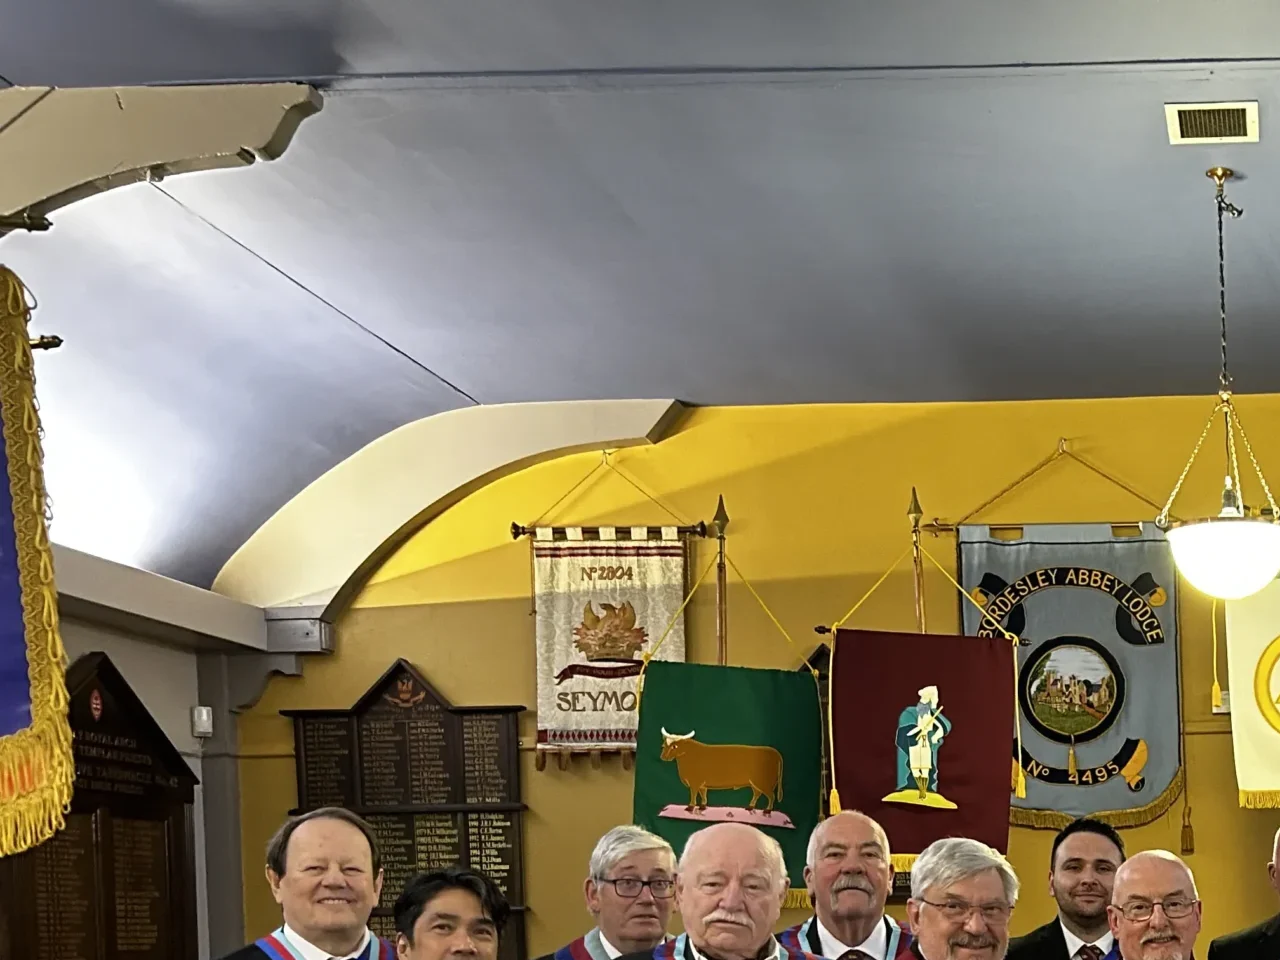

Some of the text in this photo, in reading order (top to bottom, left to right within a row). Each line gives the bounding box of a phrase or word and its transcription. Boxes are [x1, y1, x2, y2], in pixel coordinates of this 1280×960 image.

[978, 568, 1163, 643] BORDESLEY ABBEY LODGE
[556, 690, 639, 712] SEYMO
[1068, 761, 1119, 785] 4495
